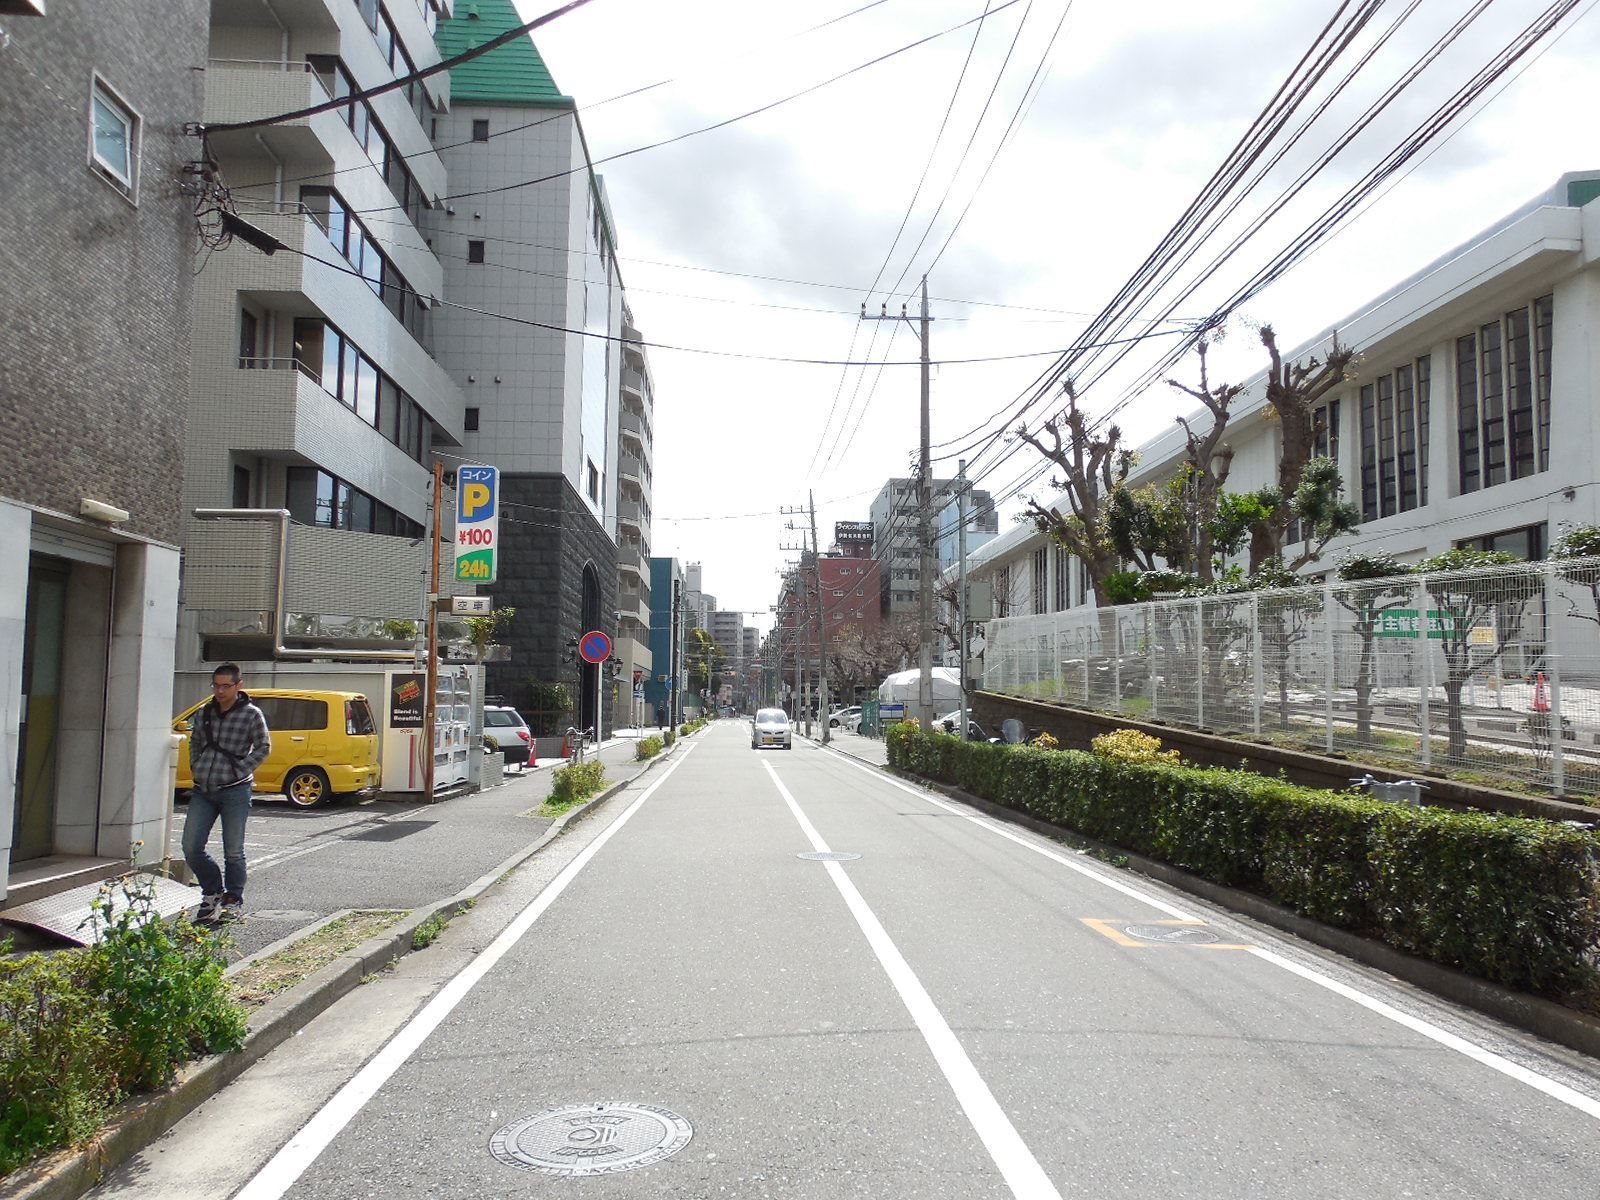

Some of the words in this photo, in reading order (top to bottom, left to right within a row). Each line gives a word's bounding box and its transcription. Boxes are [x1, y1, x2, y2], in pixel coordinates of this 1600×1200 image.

[462, 470, 492, 481] コイン
[462, 483, 490, 518] P
[459, 528, 493, 545] ¥100
[459, 559, 489, 578] 24h
[457, 600, 484, 611] 空車
